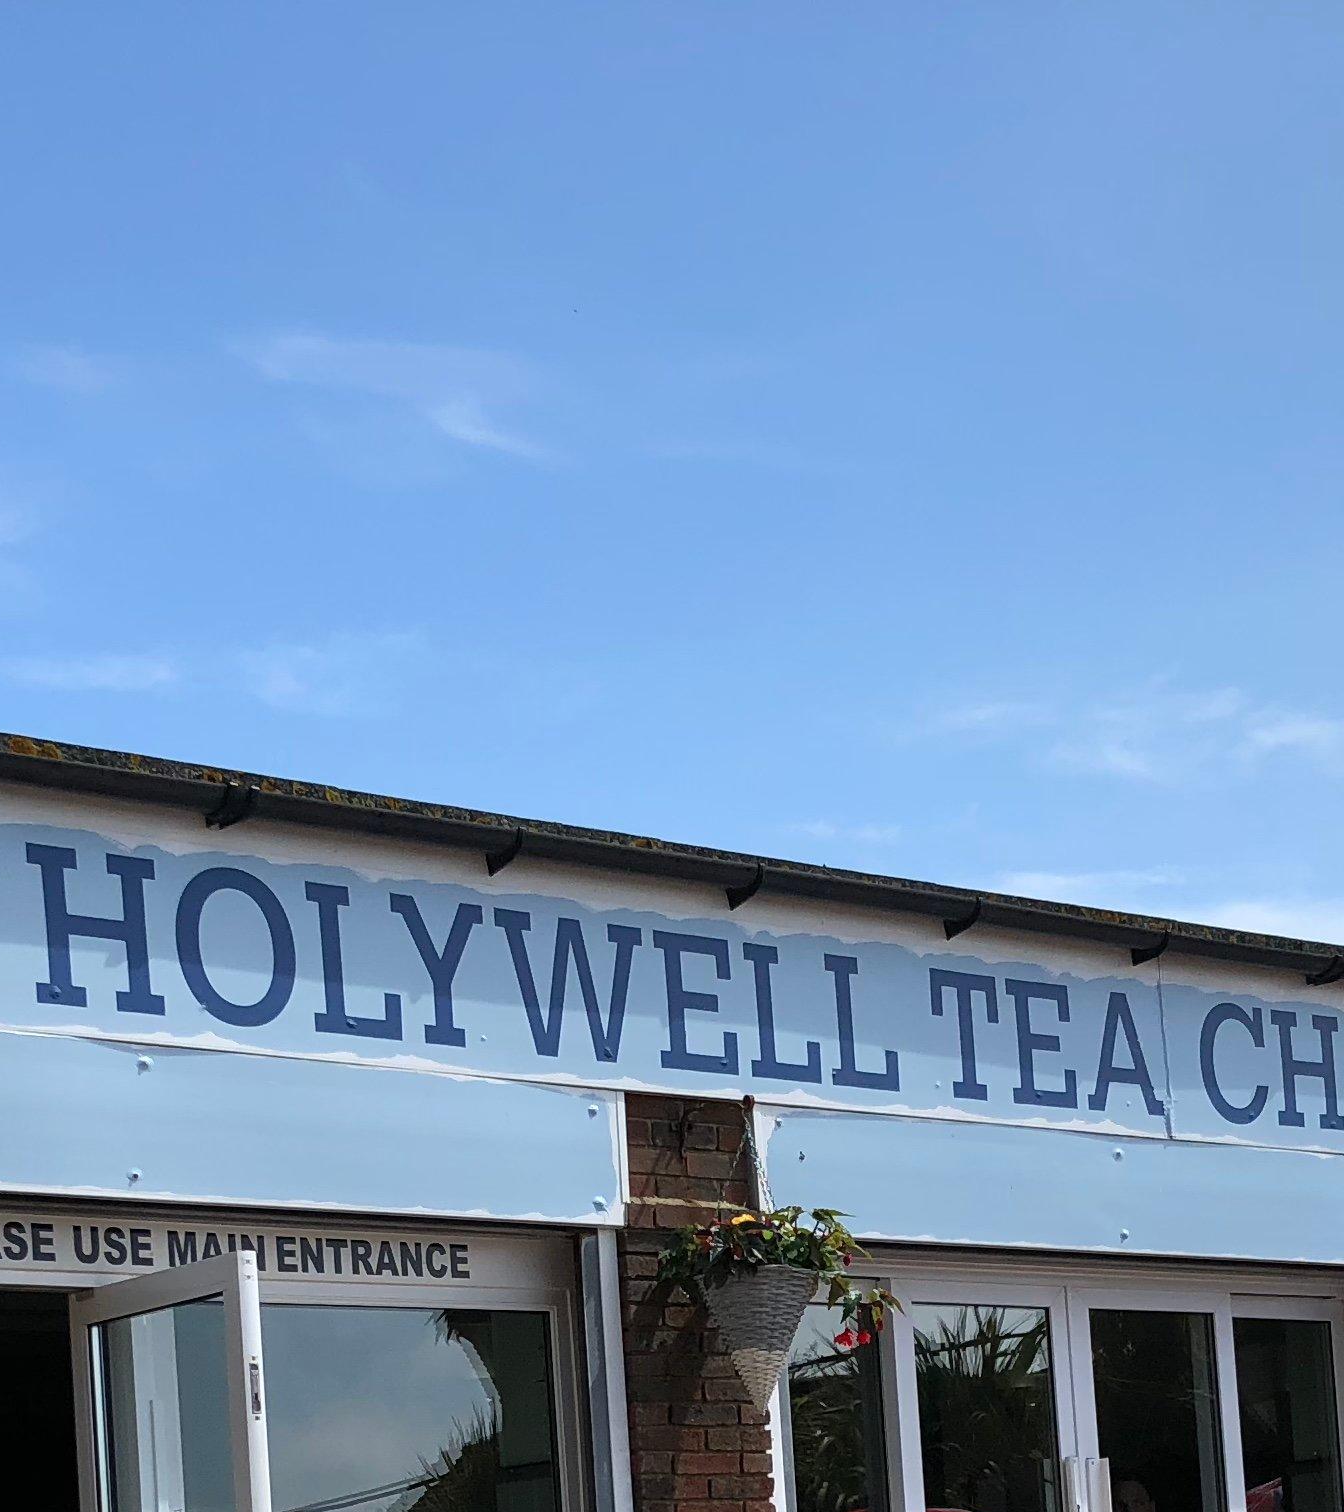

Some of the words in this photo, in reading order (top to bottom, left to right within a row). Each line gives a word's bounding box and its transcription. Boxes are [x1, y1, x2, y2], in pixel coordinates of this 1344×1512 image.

[25, 842, 899, 1092] HOLYWELL
[929, 967, 1164, 1115] TEA
[74, 1225, 154, 1267] USE
[167, 1230, 266, 1271] MAIN
[276, 1236, 471, 1280] ENTRANCE
